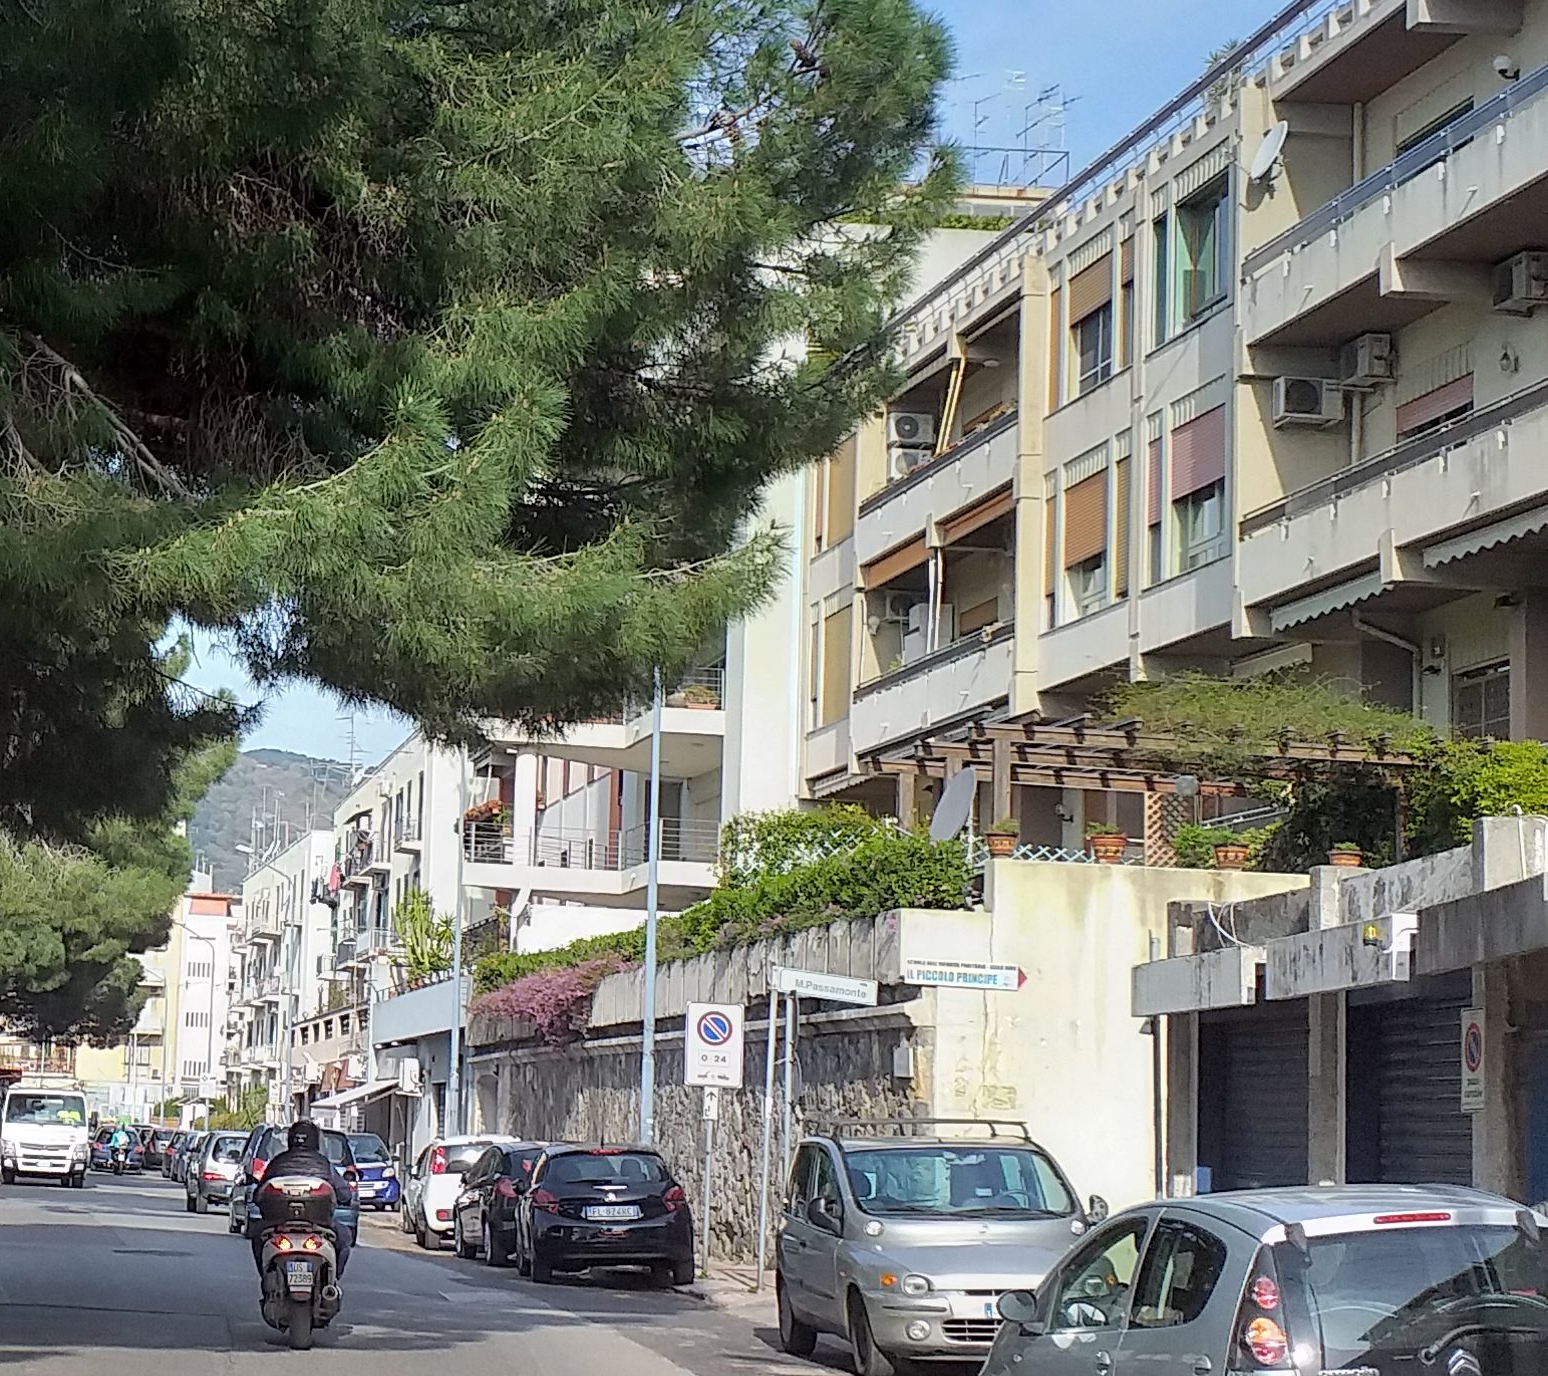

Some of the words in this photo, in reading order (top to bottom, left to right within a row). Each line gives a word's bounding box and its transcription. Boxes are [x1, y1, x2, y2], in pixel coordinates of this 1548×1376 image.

[907, 969, 915, 980] IL
[916, 969, 955, 982] PICCOLO
[956, 972, 998, 985] PRINCIPE
[714, 1055, 727, 1063] 24
